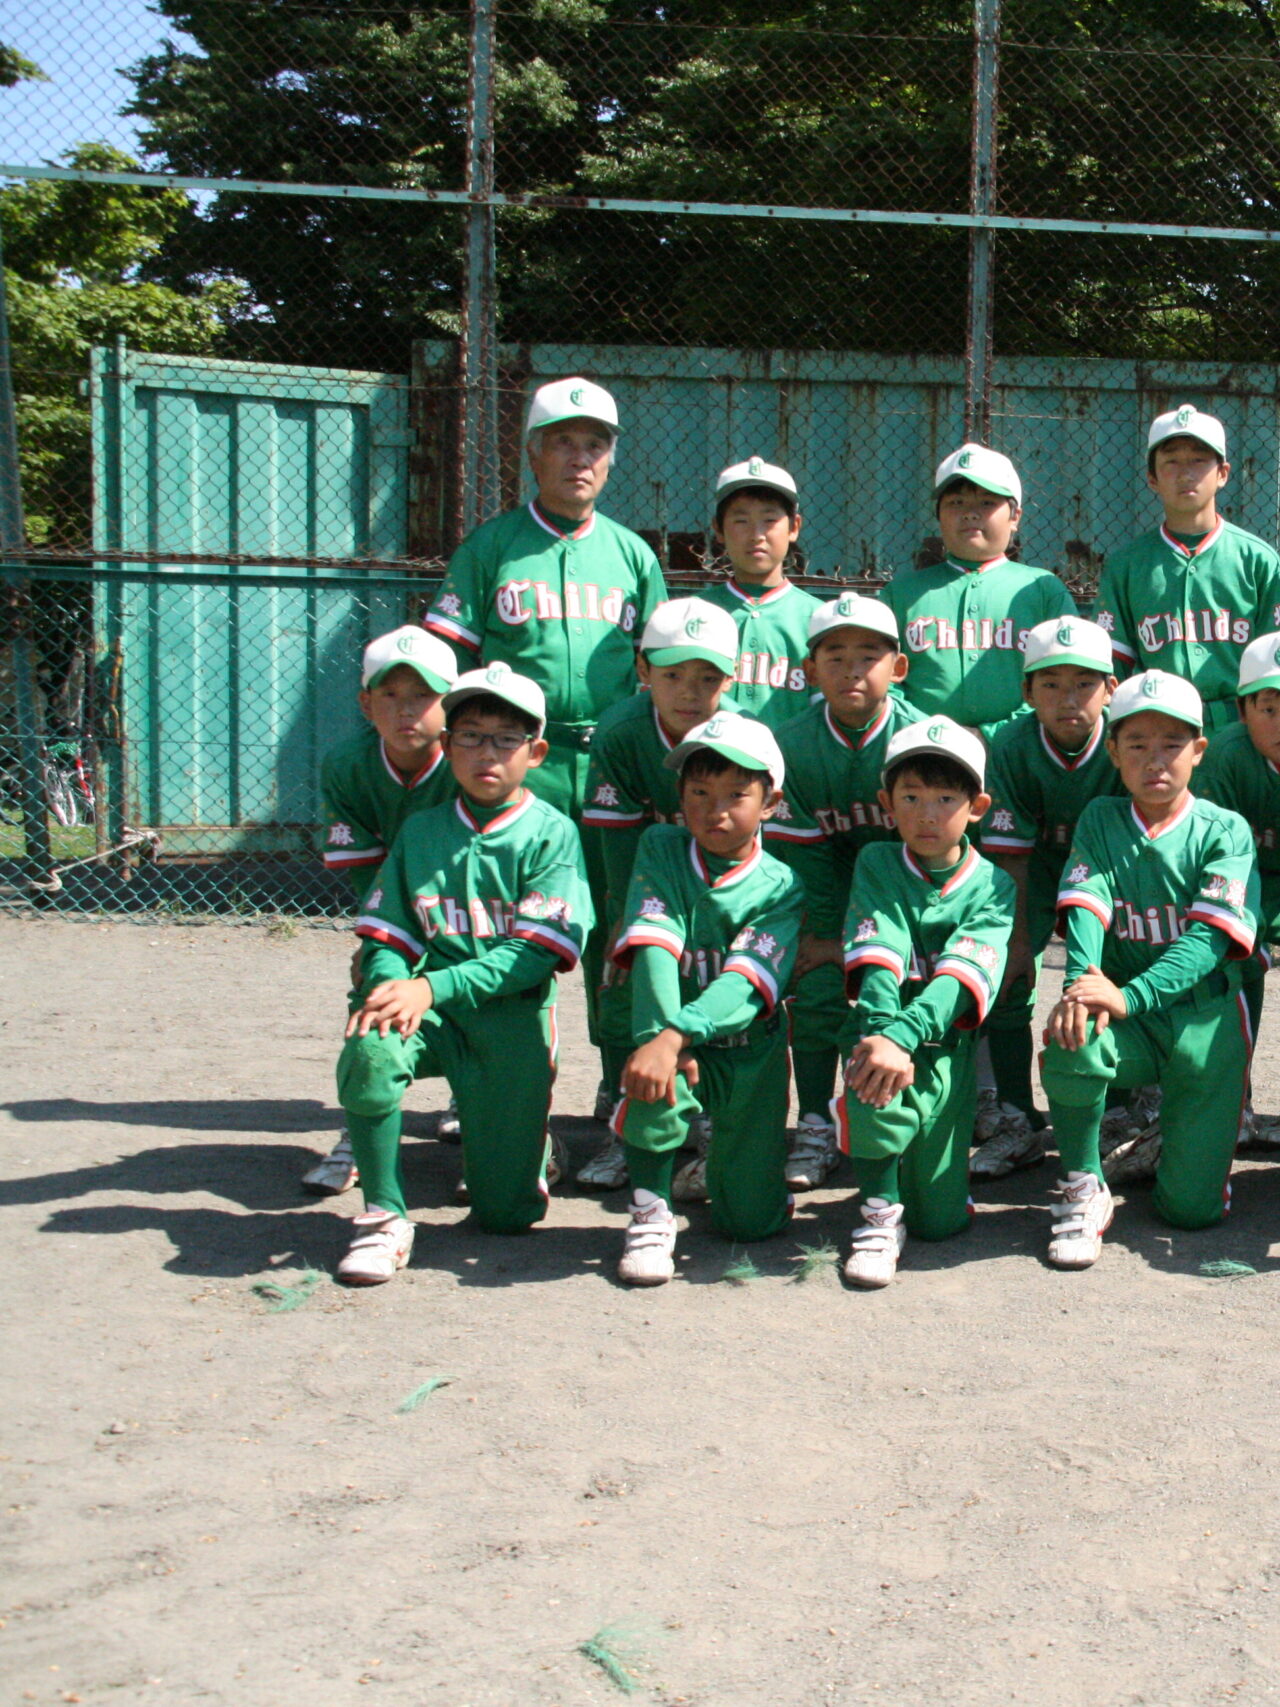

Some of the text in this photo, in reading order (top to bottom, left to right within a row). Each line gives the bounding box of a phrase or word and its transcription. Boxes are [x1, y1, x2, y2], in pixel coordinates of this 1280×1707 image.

[496, 579, 636, 632] Childs
[906, 616, 1031, 651] Childs
[1138, 609, 1250, 652] Childs
[593, 783, 620, 807] 麻
[990, 808, 1015, 831] 麻
[327, 822, 354, 846] 麻
[1067, 863, 1089, 884] 麻
